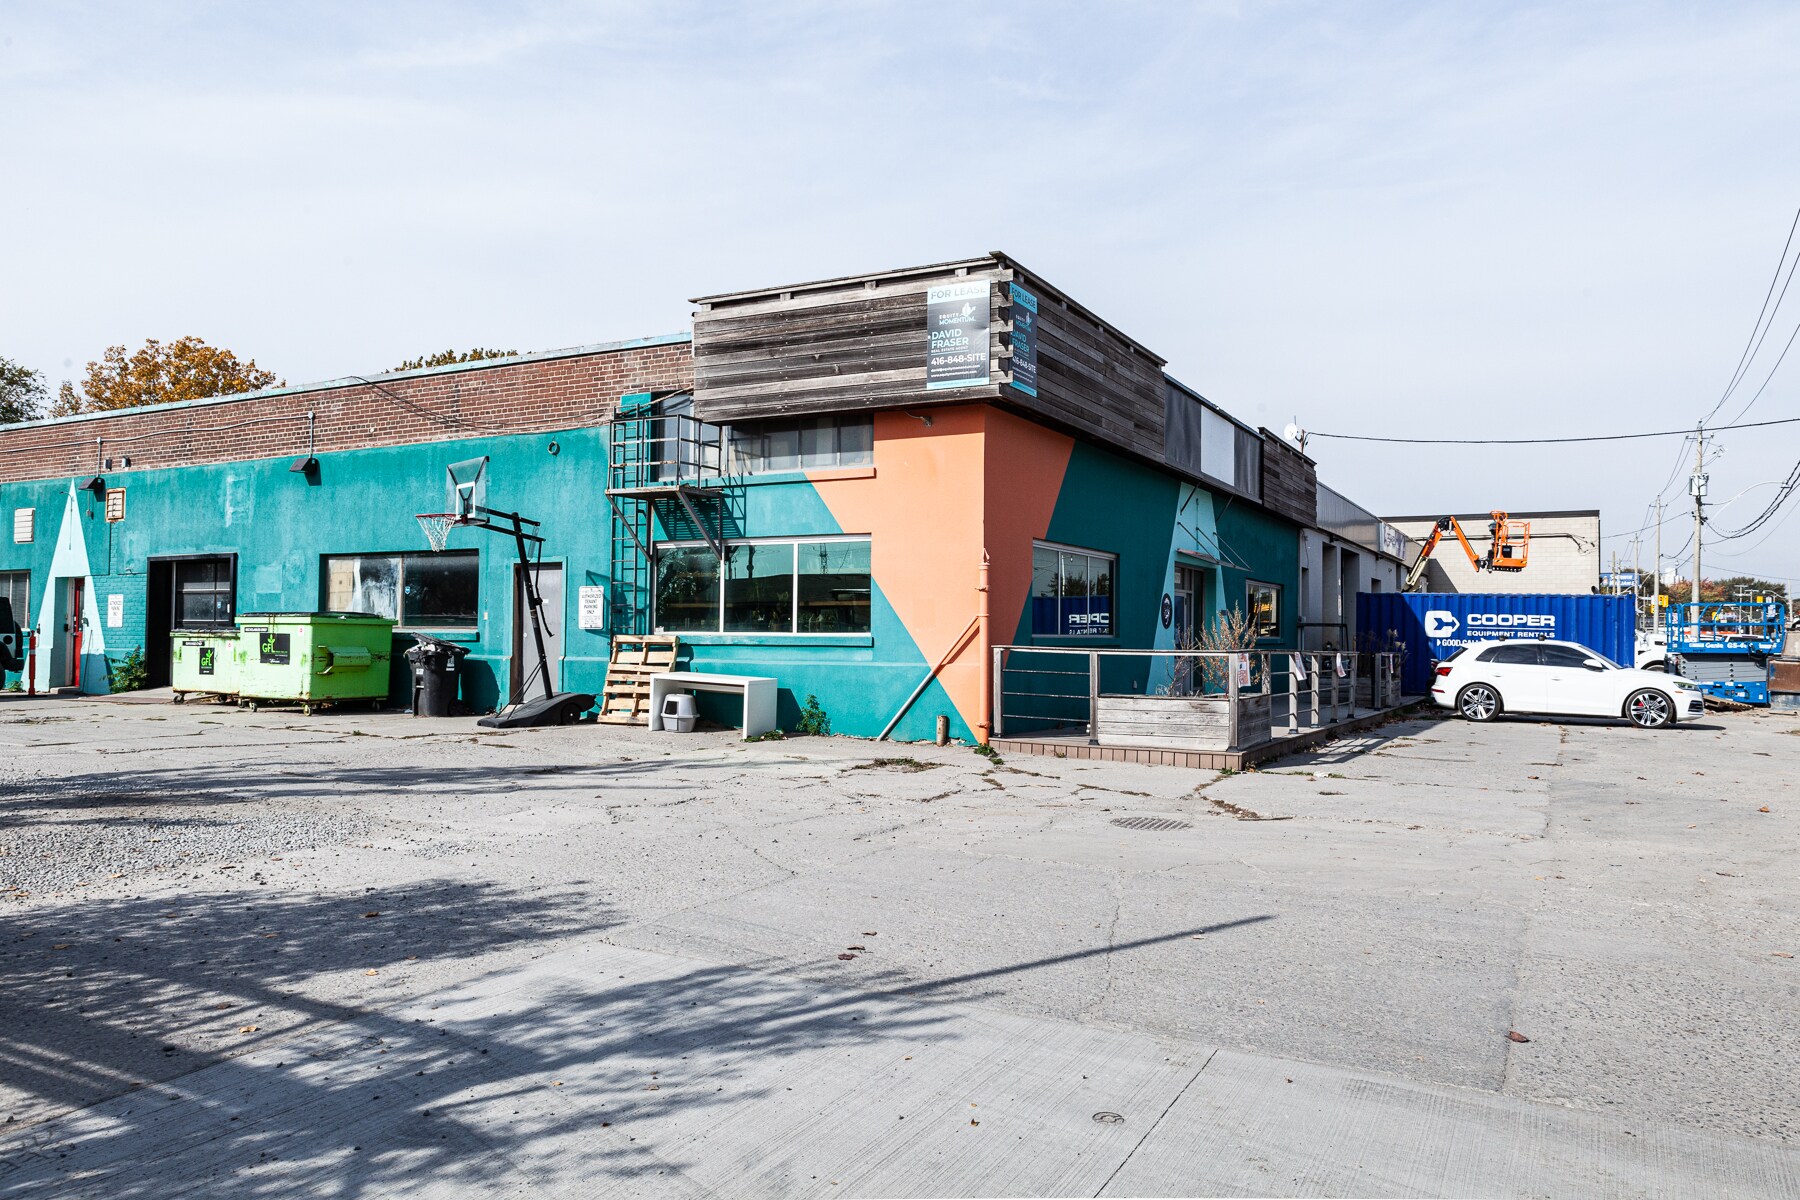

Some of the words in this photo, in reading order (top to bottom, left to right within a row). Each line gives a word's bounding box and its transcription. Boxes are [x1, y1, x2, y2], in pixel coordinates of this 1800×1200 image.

[931, 289, 951, 300] FOR
[954, 285, 986, 296] LEASE
[1012, 287, 1022, 300] FOR
[1022, 292, 1036, 309] LEASE
[931, 328, 962, 340] DAVID
[1012, 329, 1027, 342] DAVID
[931, 337, 969, 349] FRASER
[1012, 339, 1030, 353] FRASER
[931, 352, 986, 365] 416-848-SITE
[1467, 613, 1556, 627] COOPER
[1466, 630, 1515, 638] EQUIPMENT
[262, 642, 276, 653] GFL
[1441, 639, 1460, 647] GOOD
